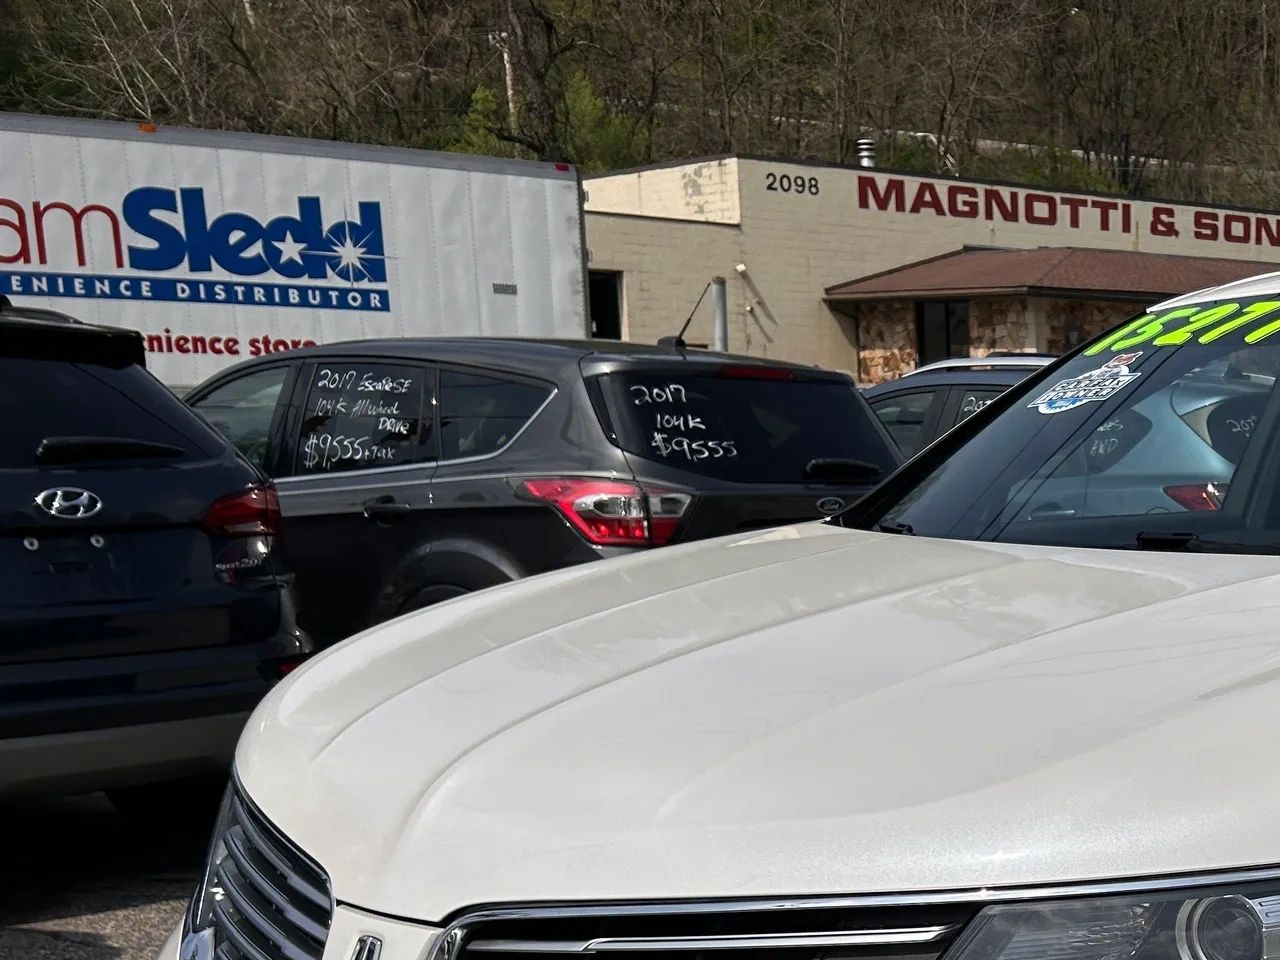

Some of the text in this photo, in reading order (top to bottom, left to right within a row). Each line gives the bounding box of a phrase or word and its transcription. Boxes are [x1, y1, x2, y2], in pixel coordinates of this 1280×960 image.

[765, 172, 820, 196] 2098
[857, 175, 1132, 234] MAGNOTTI
[1150, 206, 1181, 239] &
[0, 274, 383, 309] ENIENCE DISTRIBUTOR
[144, 327, 241, 355] nience
[318, 369, 357, 390] 2017
[630, 384, 687, 405] 2017
